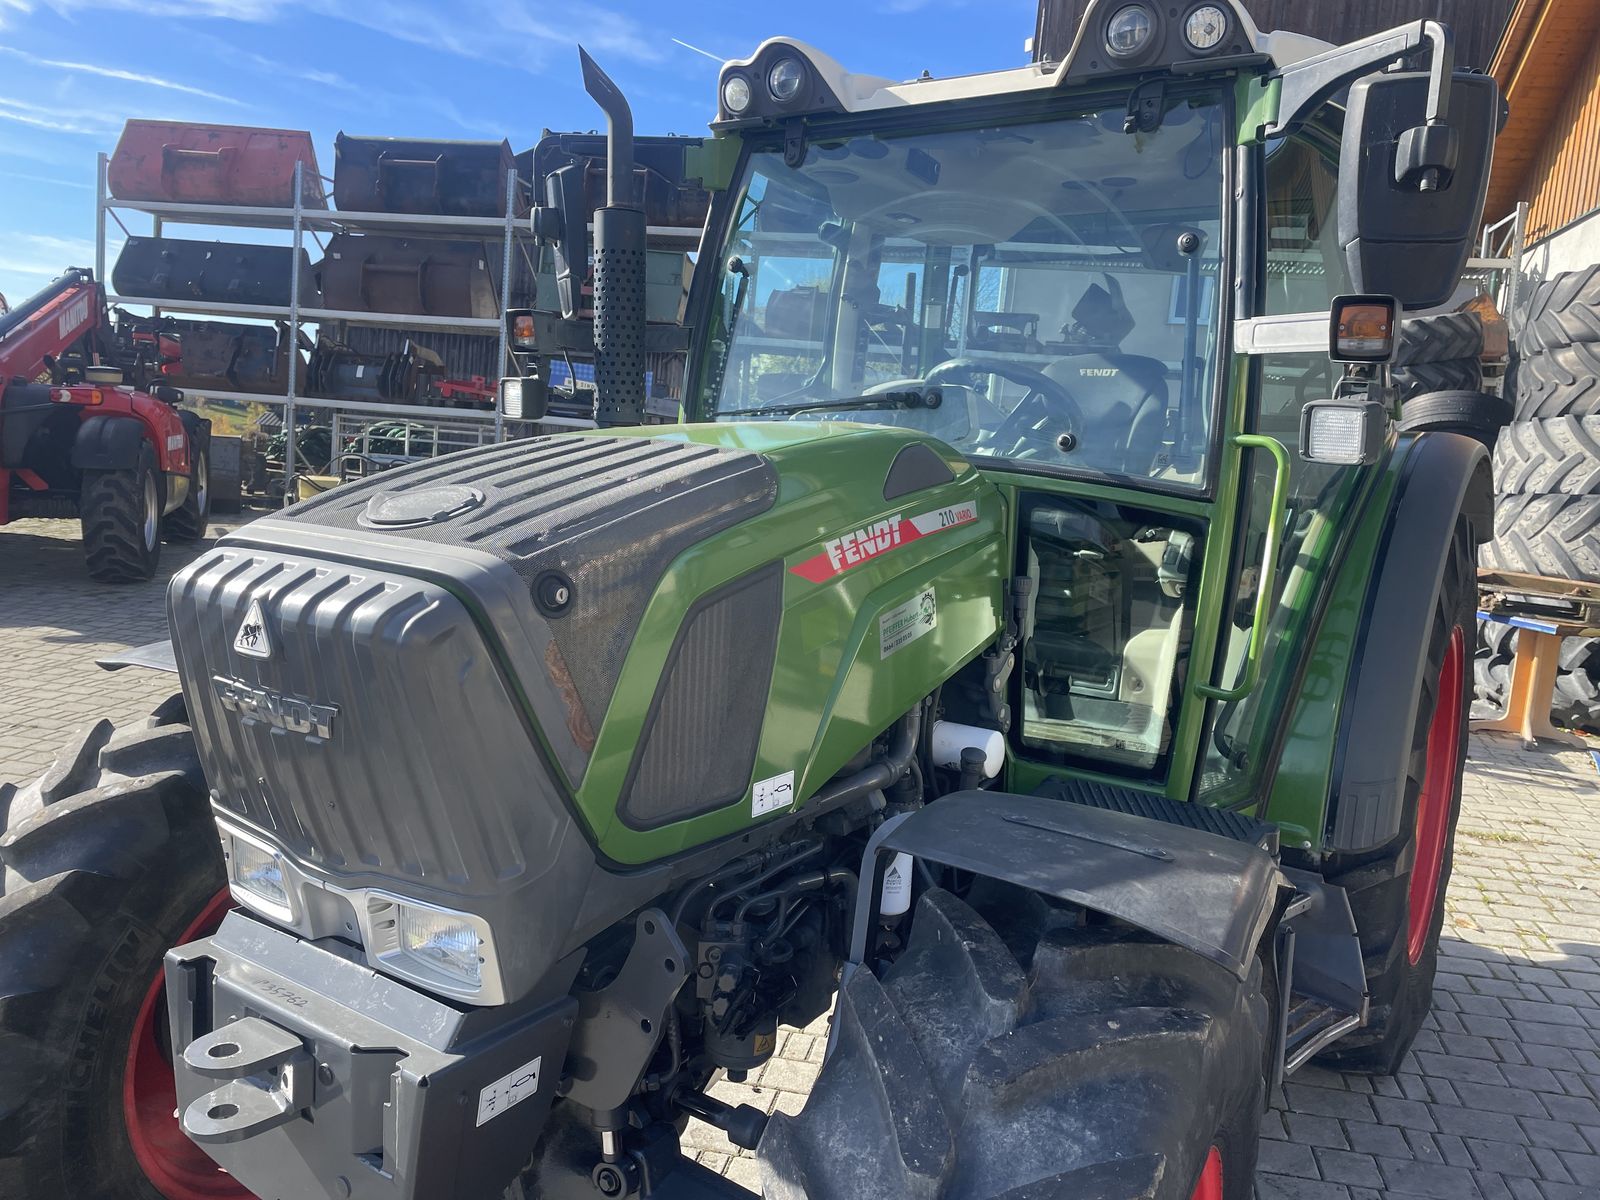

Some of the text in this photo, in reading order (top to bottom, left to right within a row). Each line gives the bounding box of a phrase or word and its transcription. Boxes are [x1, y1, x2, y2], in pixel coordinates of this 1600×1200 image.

[1080, 368, 1119, 377] FENDT
[939, 508, 972, 527] 210 VARIO
[824, 513, 902, 571] FENDT
[212, 675, 338, 740] FENDT
